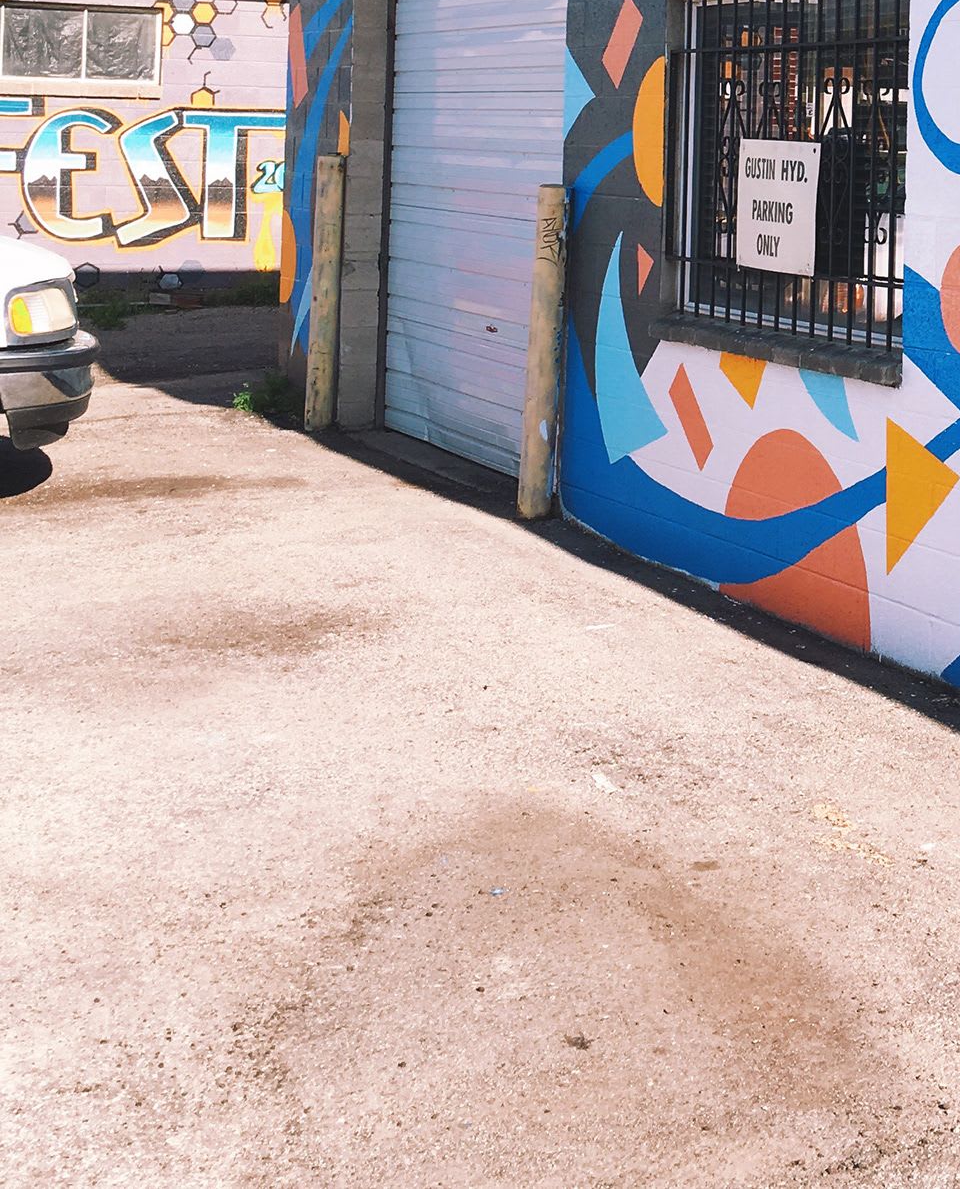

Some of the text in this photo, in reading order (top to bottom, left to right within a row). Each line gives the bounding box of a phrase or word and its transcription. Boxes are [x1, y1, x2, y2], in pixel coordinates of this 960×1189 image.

[745, 156, 808, 183] GUSTIN HYD.
[751, 199, 794, 225] PARKING
[756, 233, 781, 258] ONLY
